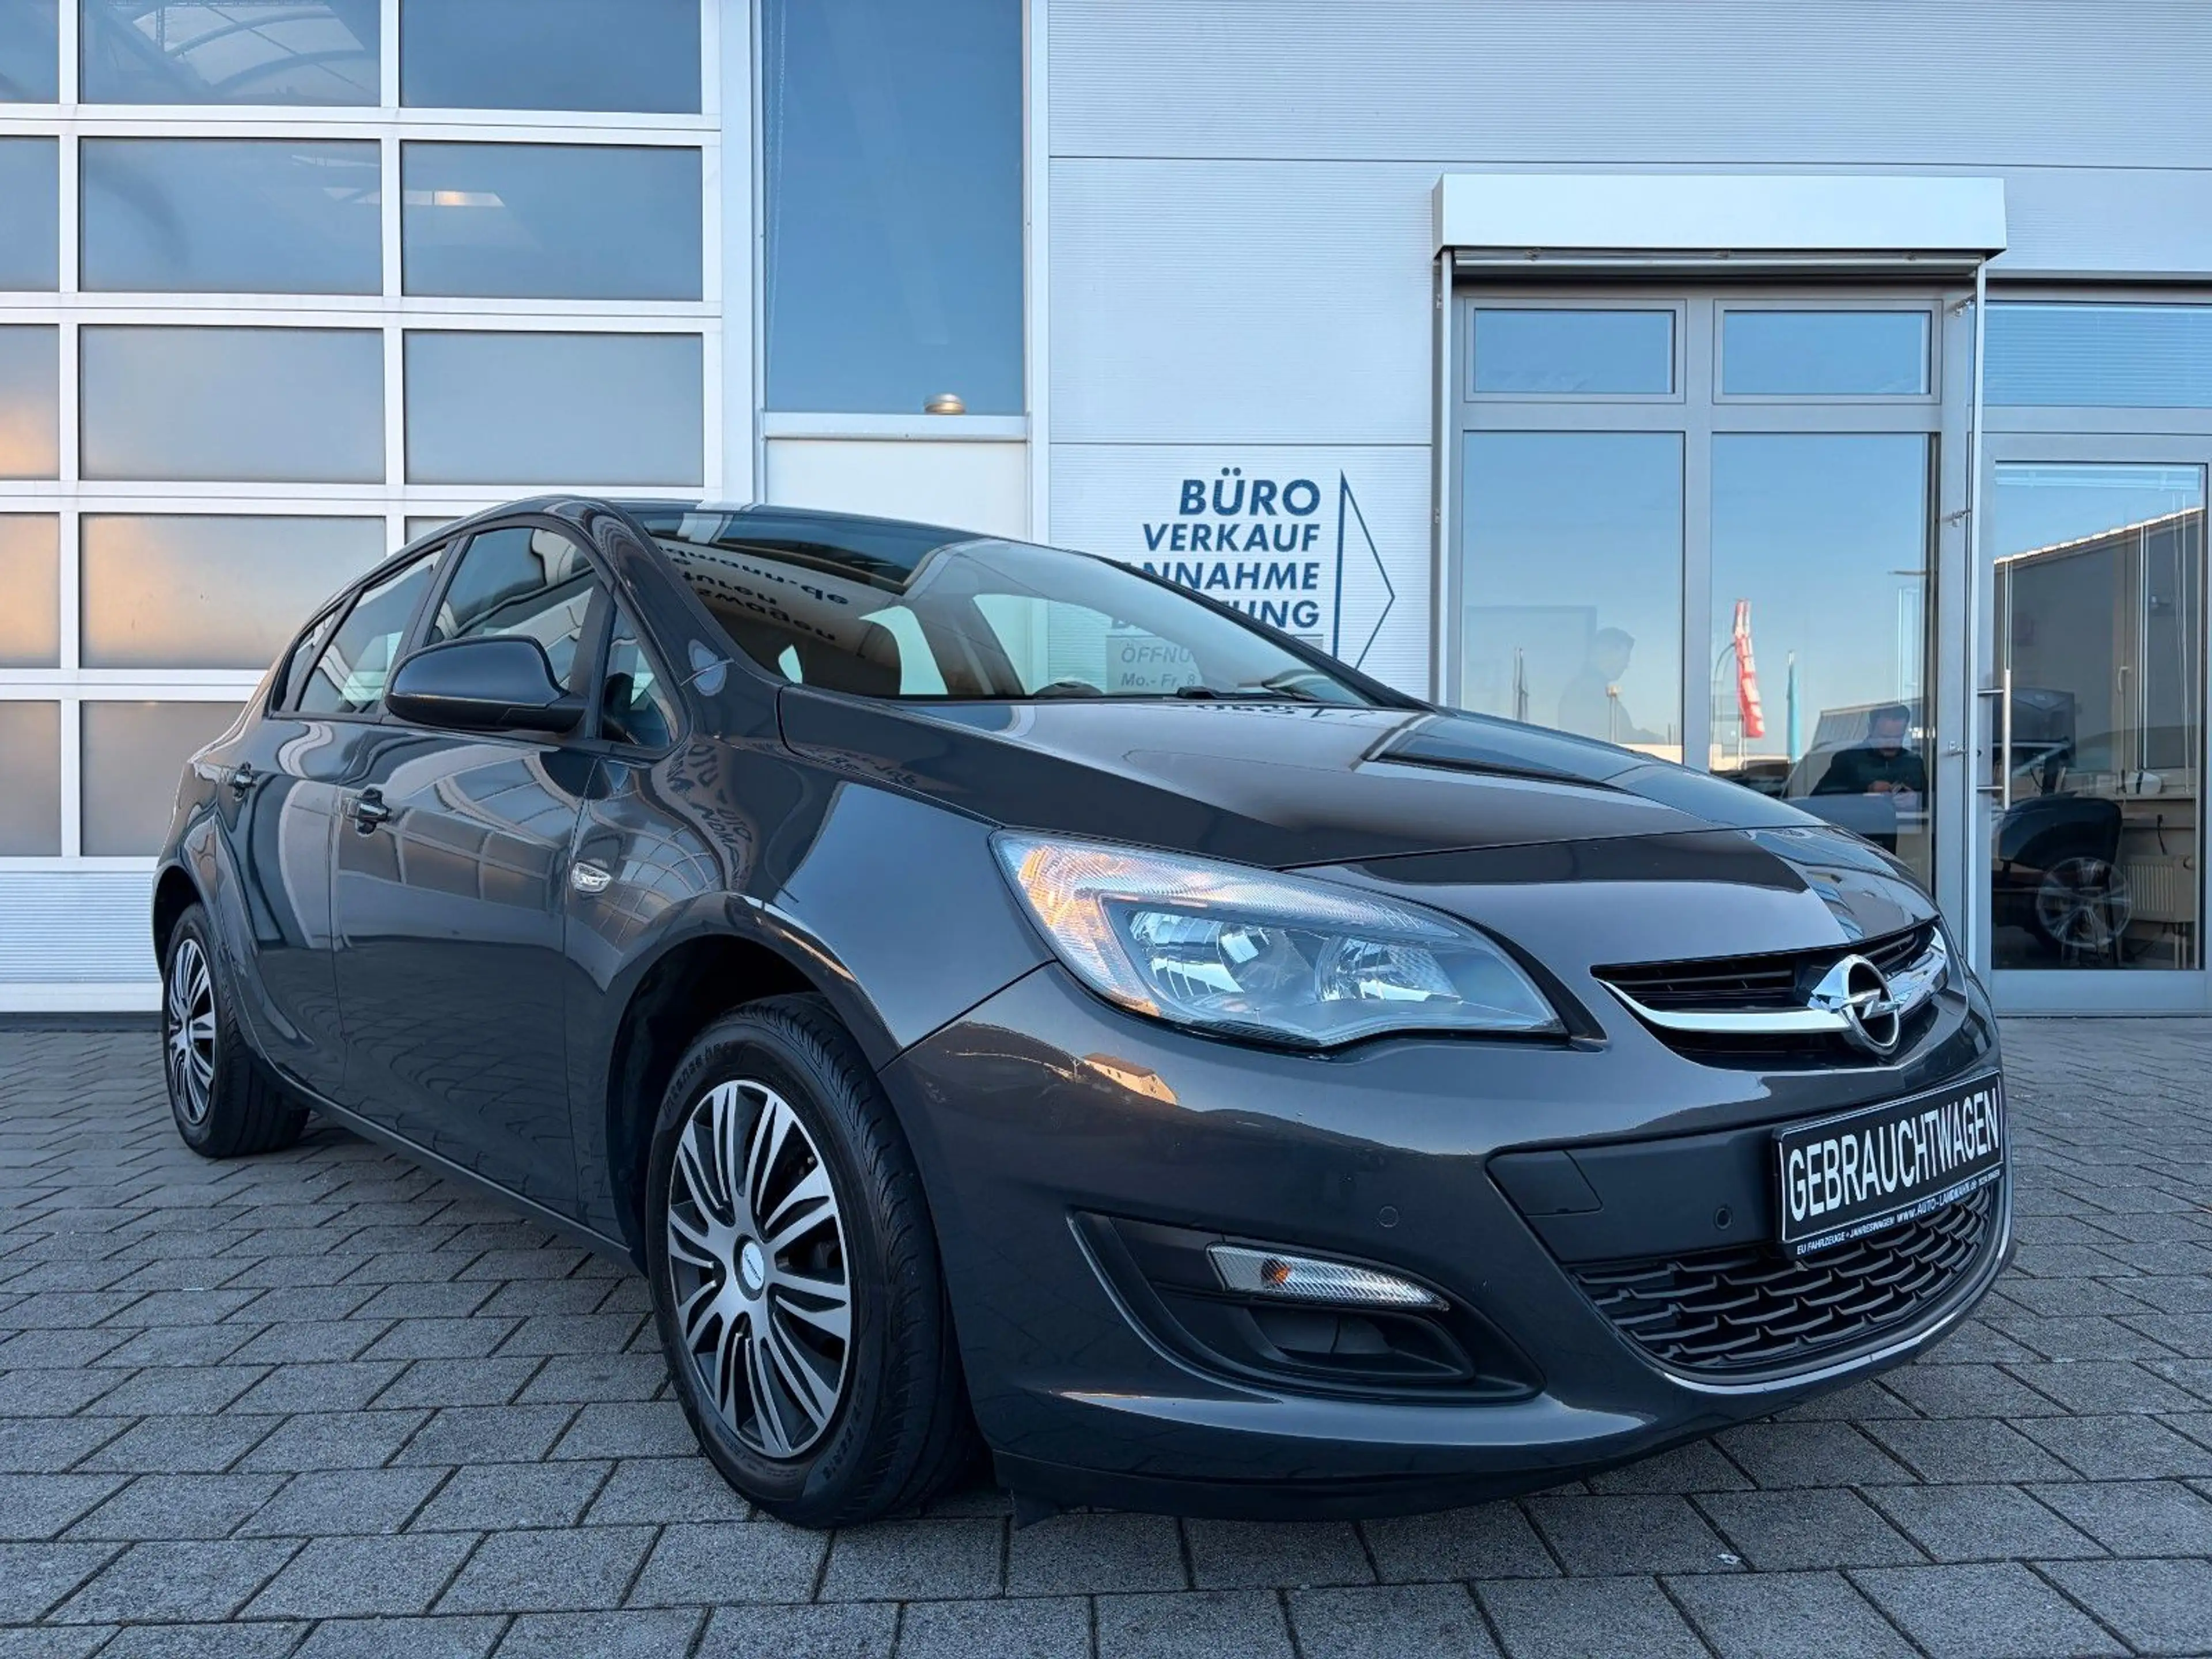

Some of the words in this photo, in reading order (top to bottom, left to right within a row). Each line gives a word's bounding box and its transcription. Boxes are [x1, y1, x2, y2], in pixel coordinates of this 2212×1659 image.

[1179, 467, 1320, 516] BÜRO
[1143, 524, 1320, 552] VERKAUF
[1120, 562, 1320, 589] NNAHME
[1789, 1087, 1999, 1222] GEBRAUCHTWAGEN
